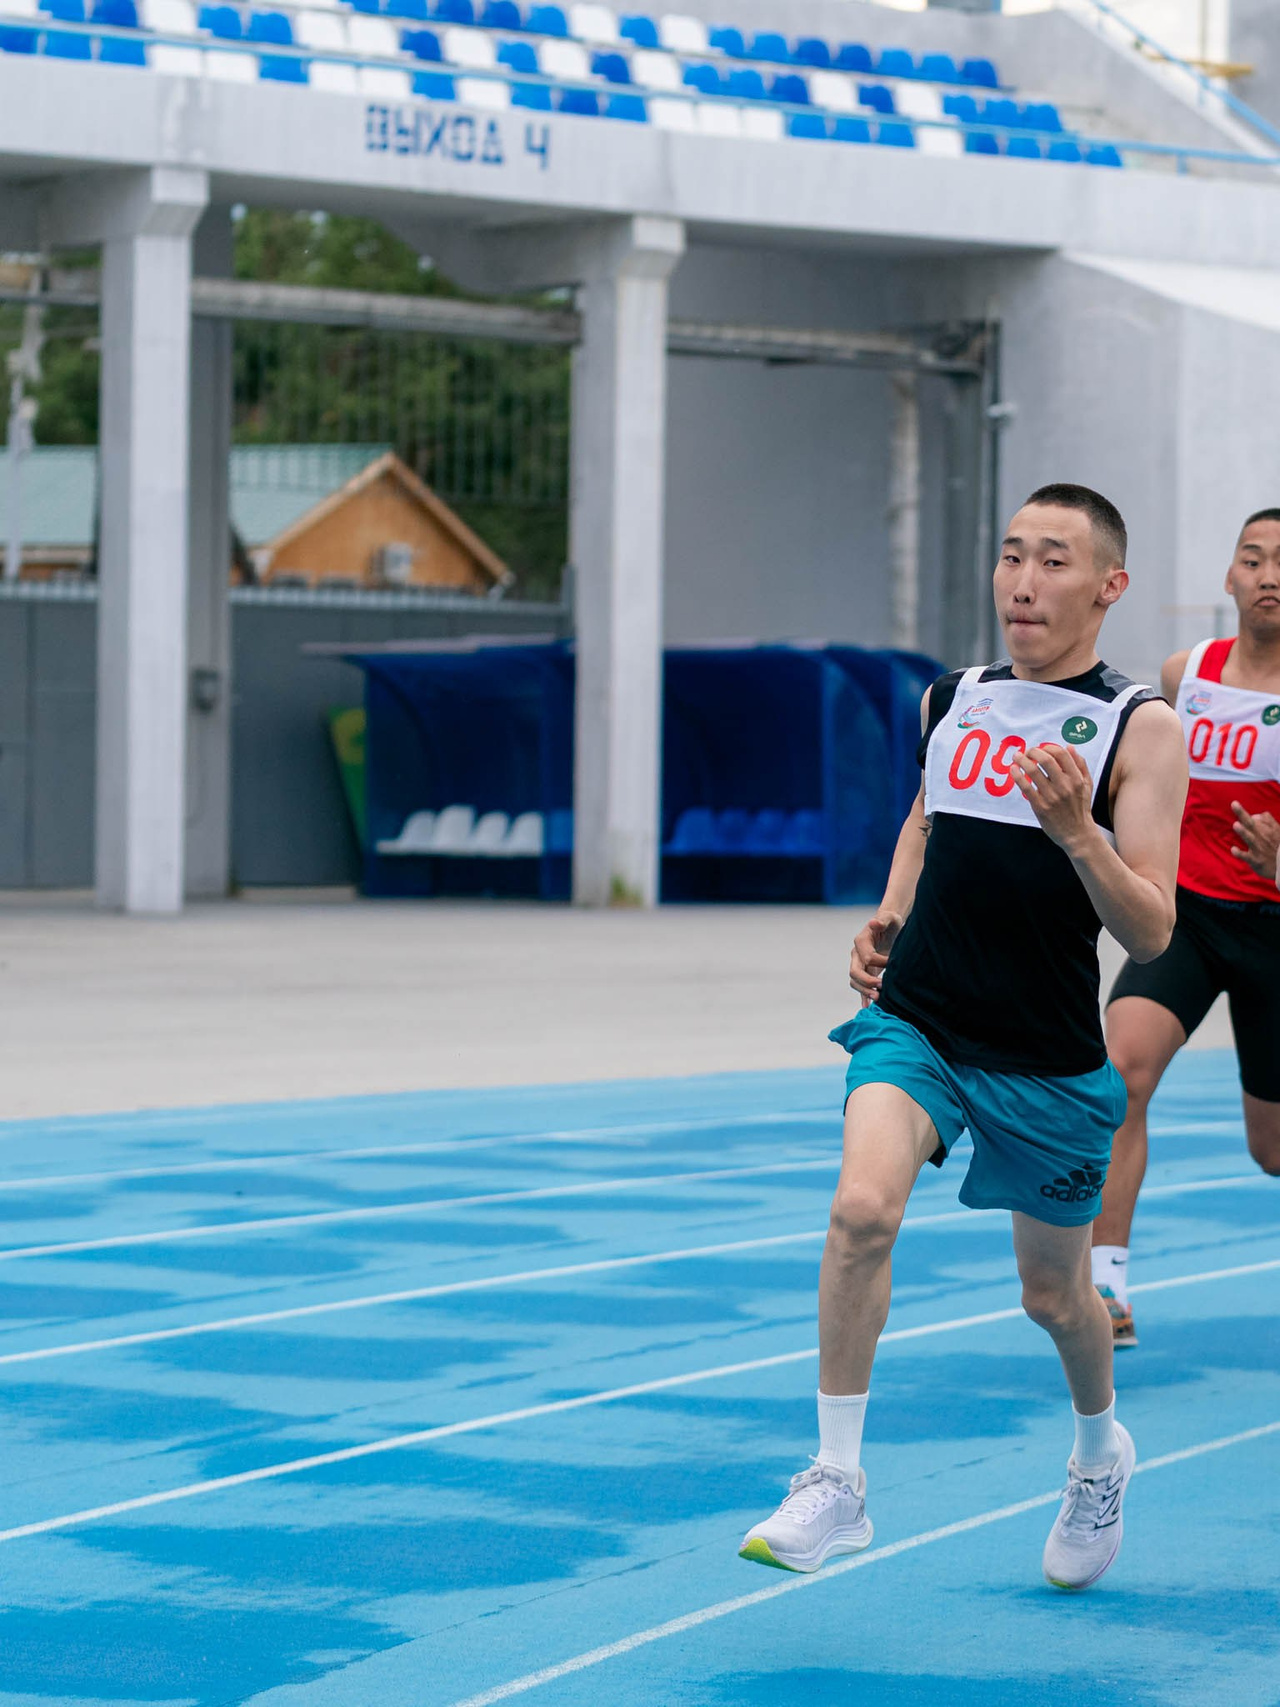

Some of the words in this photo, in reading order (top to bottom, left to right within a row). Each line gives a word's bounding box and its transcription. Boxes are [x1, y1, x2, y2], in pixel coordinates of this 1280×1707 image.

[366, 103, 504, 165] ВЫХОД
[525, 122, 549, 170] 4
[1188, 717, 1258, 770] 010
